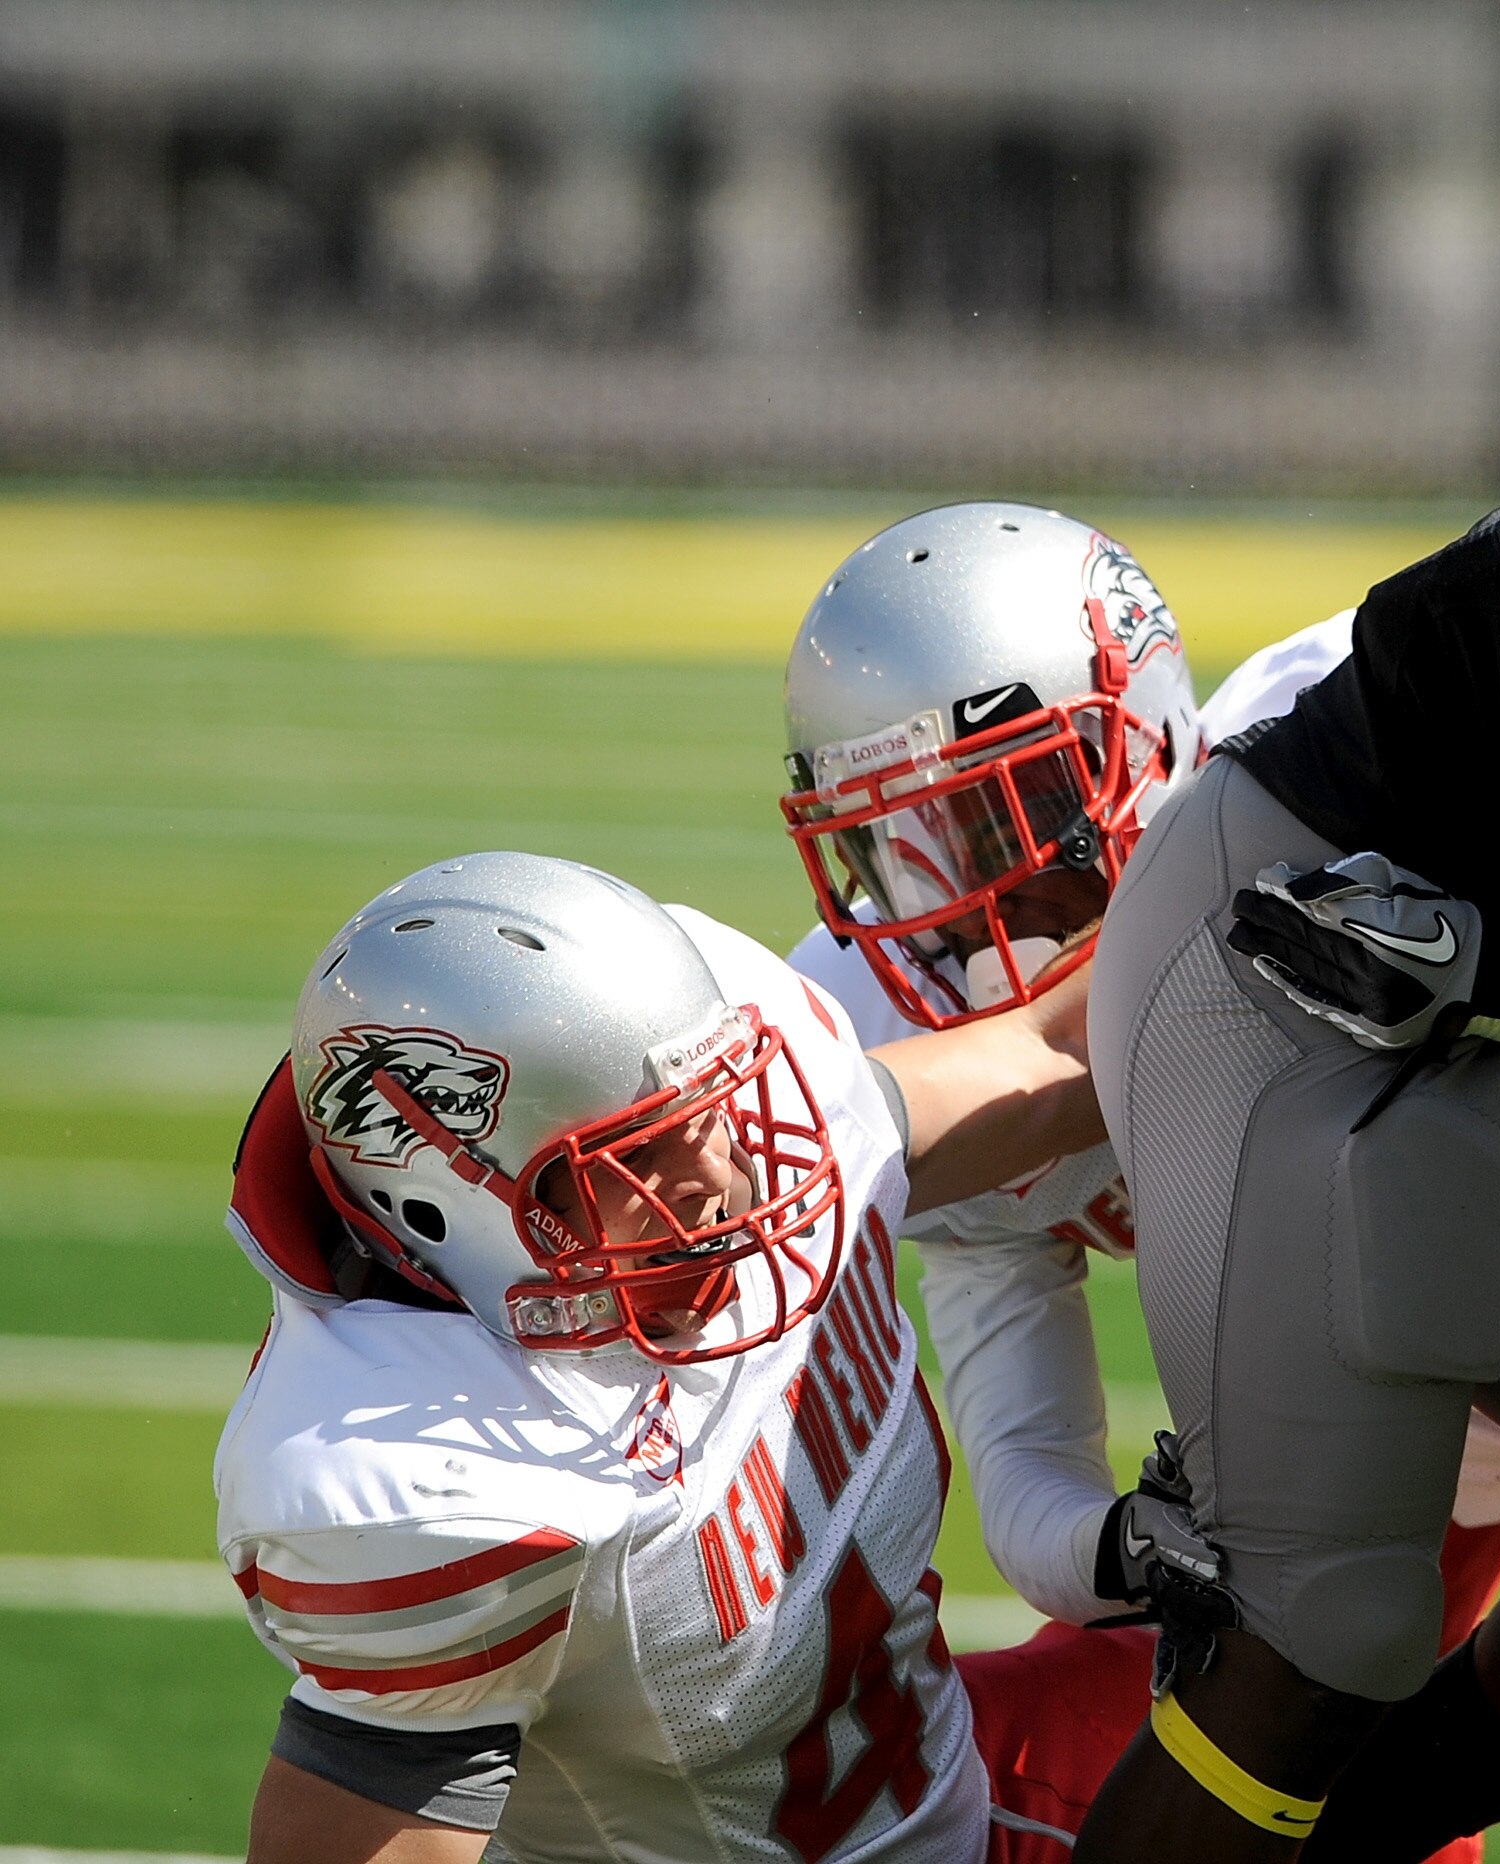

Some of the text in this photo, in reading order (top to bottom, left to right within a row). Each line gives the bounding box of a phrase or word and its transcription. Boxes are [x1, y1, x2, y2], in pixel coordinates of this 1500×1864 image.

[850, 735, 908, 764] LOBOS
[686, 1026, 725, 1062] LOBOS
[694, 1202, 902, 1648] NEW MEXICO
